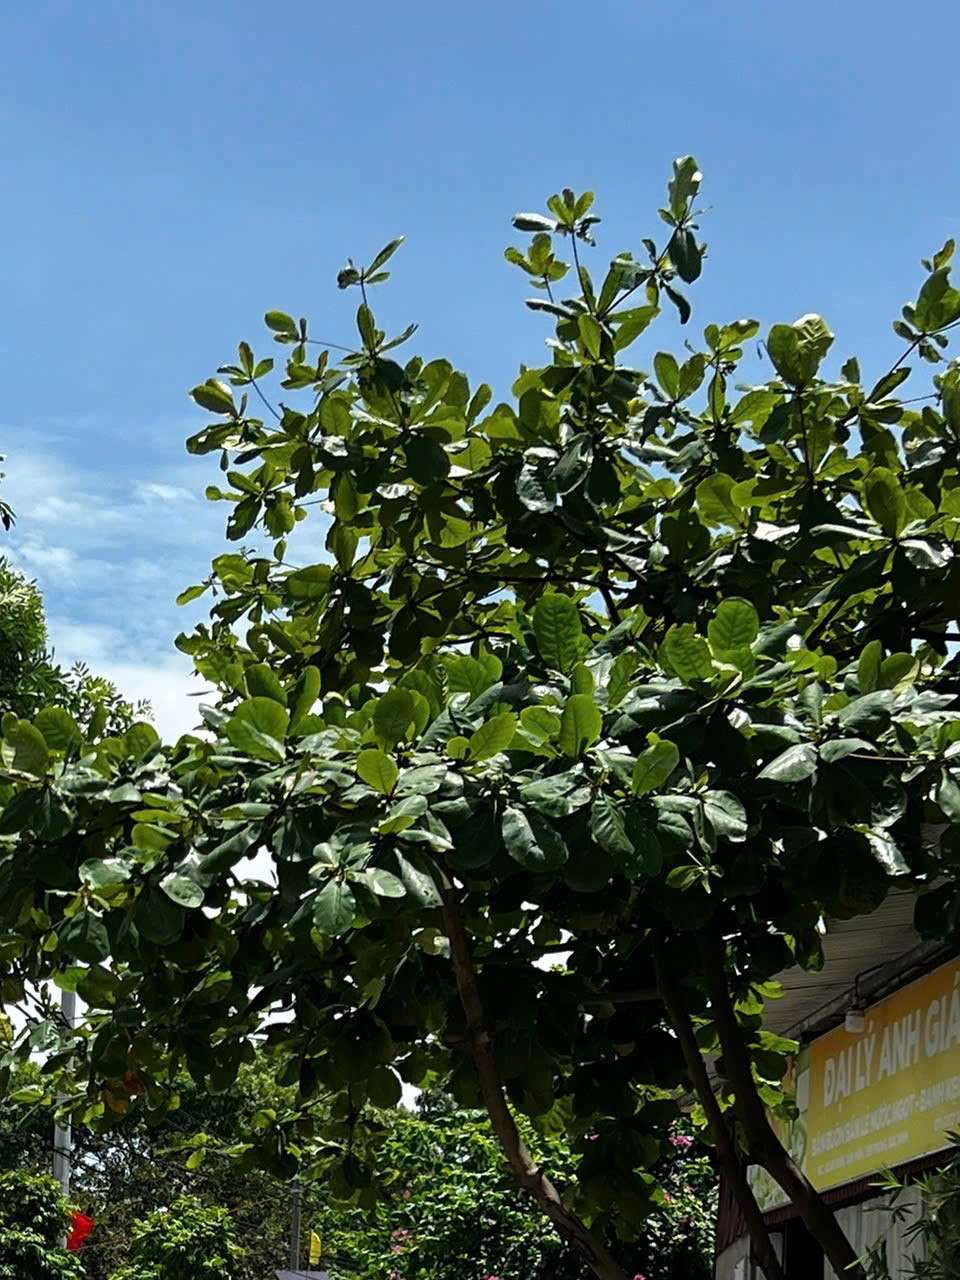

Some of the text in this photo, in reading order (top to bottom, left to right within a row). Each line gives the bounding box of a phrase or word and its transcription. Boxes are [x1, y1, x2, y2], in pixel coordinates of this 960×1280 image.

[823, 1046, 852, 1112] ĐẠI
[855, 1019, 877, 1092] LÝ
[878, 1008, 921, 1081] ANH
